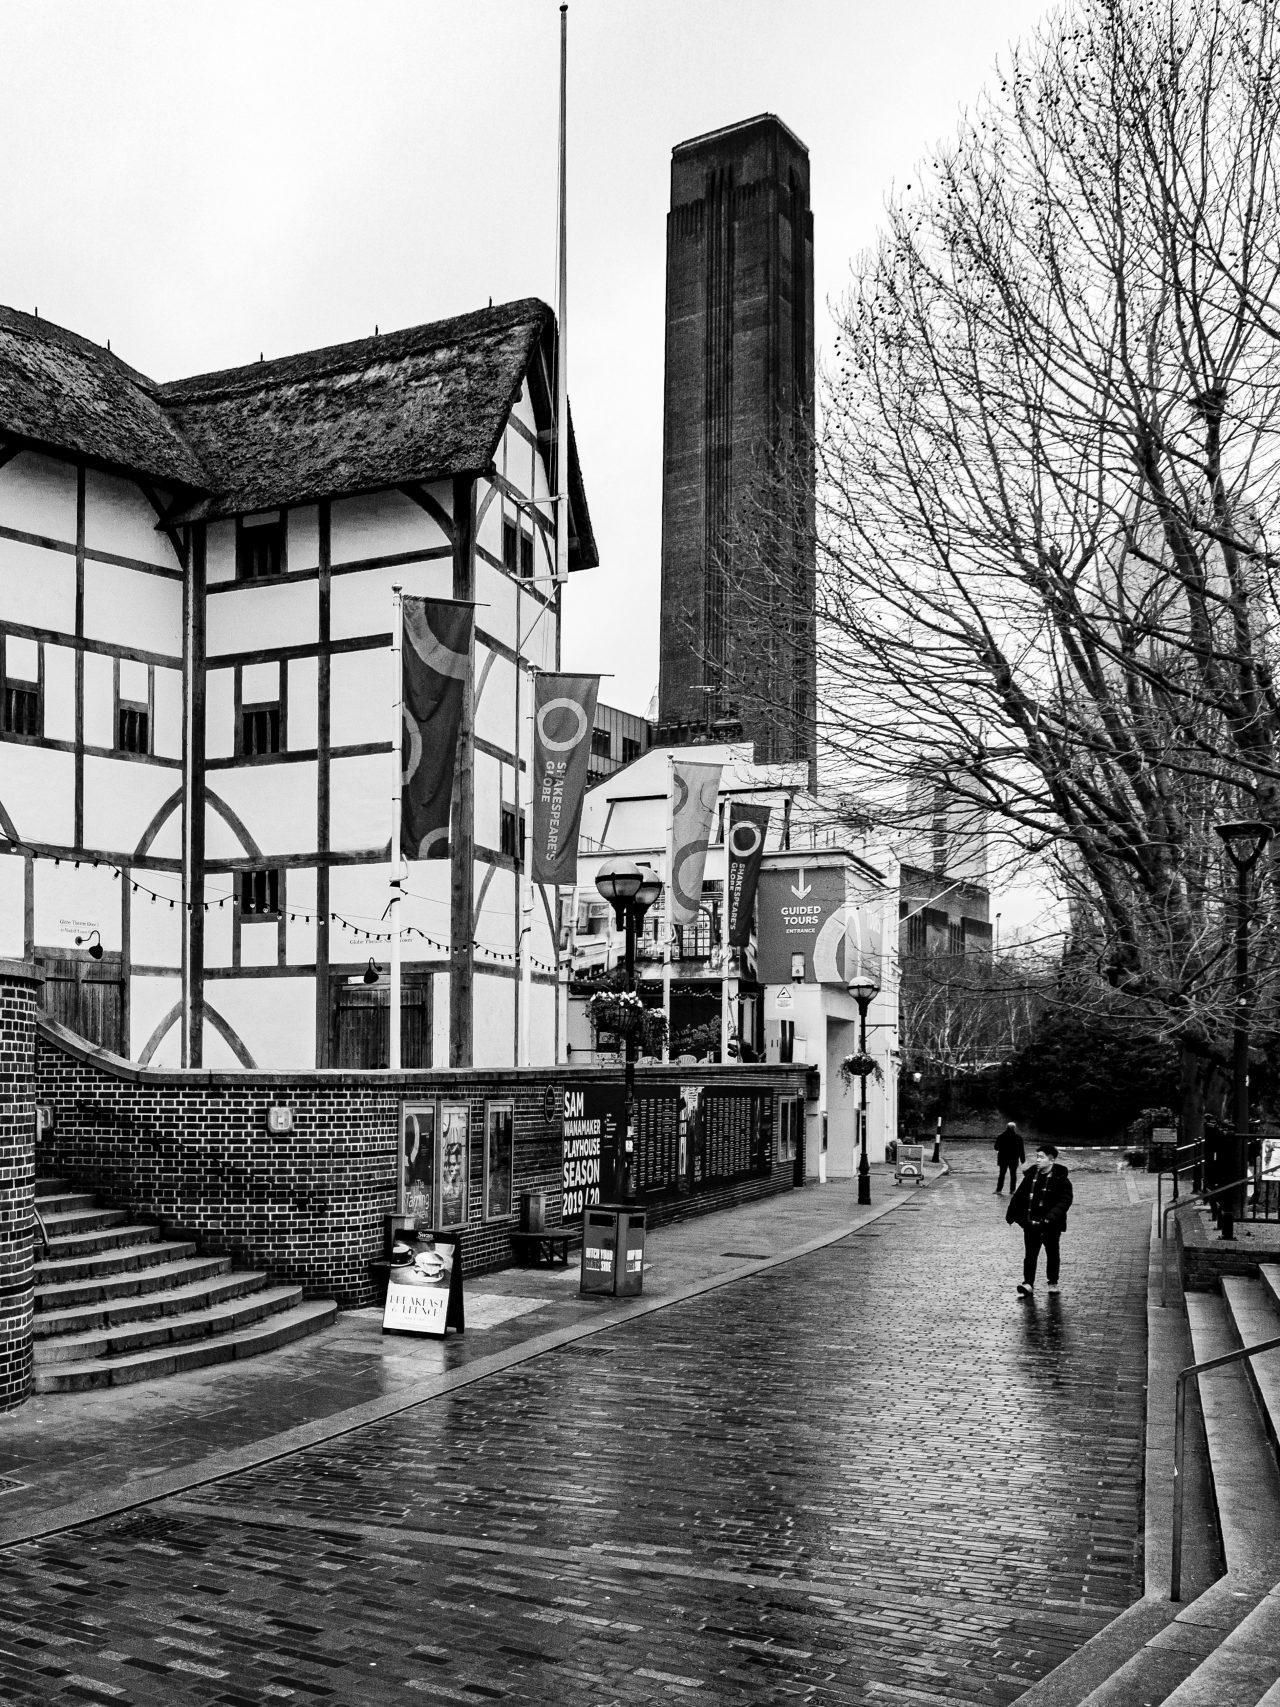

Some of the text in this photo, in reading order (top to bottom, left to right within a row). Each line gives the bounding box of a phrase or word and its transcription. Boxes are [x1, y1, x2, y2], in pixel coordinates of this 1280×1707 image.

[541, 760, 555, 803] GLOBE
[546, 762, 567, 861] SHAKESPEARE'S
[729, 862, 739, 891] GLOBE
[730, 863, 746, 930] SHAKESPEARE'S
[780, 906, 821, 915] GUIDED
[783, 916, 819, 925] TOURS
[564, 1091, 584, 1118] SAM
[564, 1119, 600, 1136] WANAMAKER
[564, 1138, 600, 1158] PLAYHOUSE
[563, 1158, 600, 1188] SEASON
[405, 1191, 430, 1210] Taming
